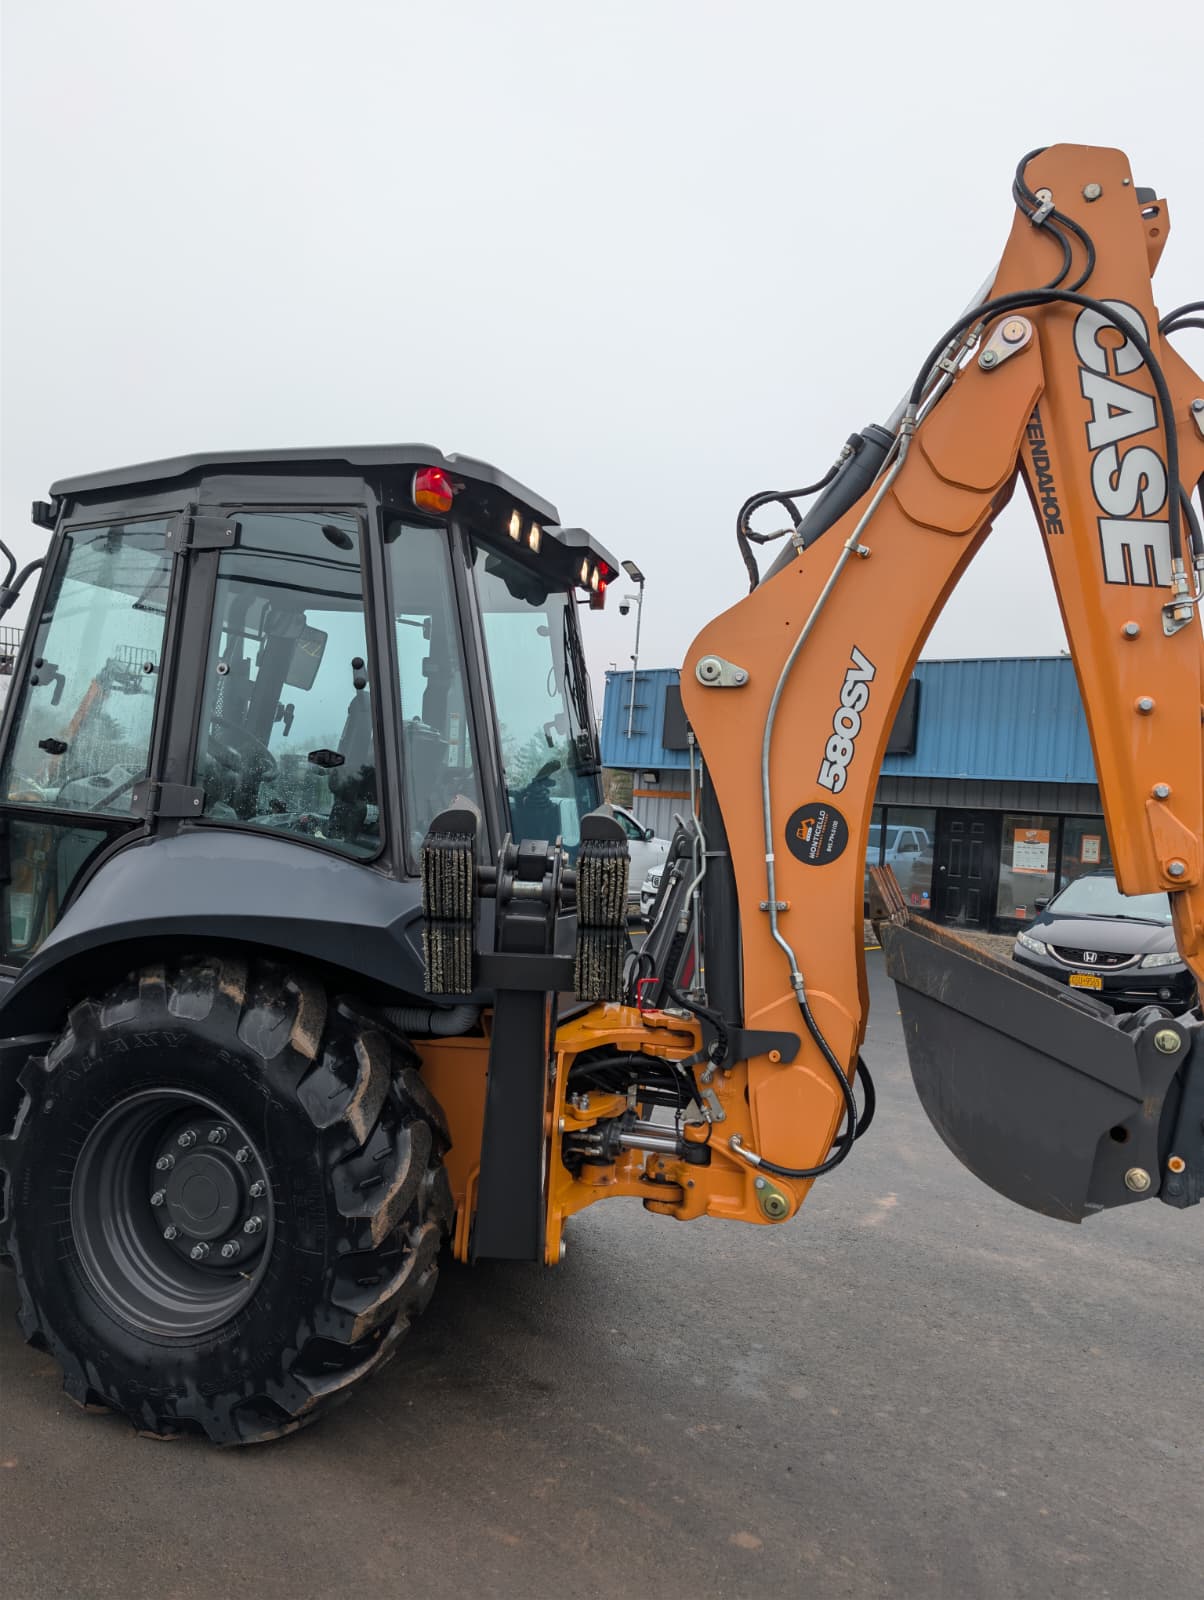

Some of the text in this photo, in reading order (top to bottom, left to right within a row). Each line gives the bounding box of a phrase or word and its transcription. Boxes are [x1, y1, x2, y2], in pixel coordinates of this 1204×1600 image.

[1025, 403, 1065, 535] TENDAHOE
[1072, 299, 1173, 588] CASE
[816, 644, 877, 795] 580SV
[808, 810, 826, 859] MONTICELLO
